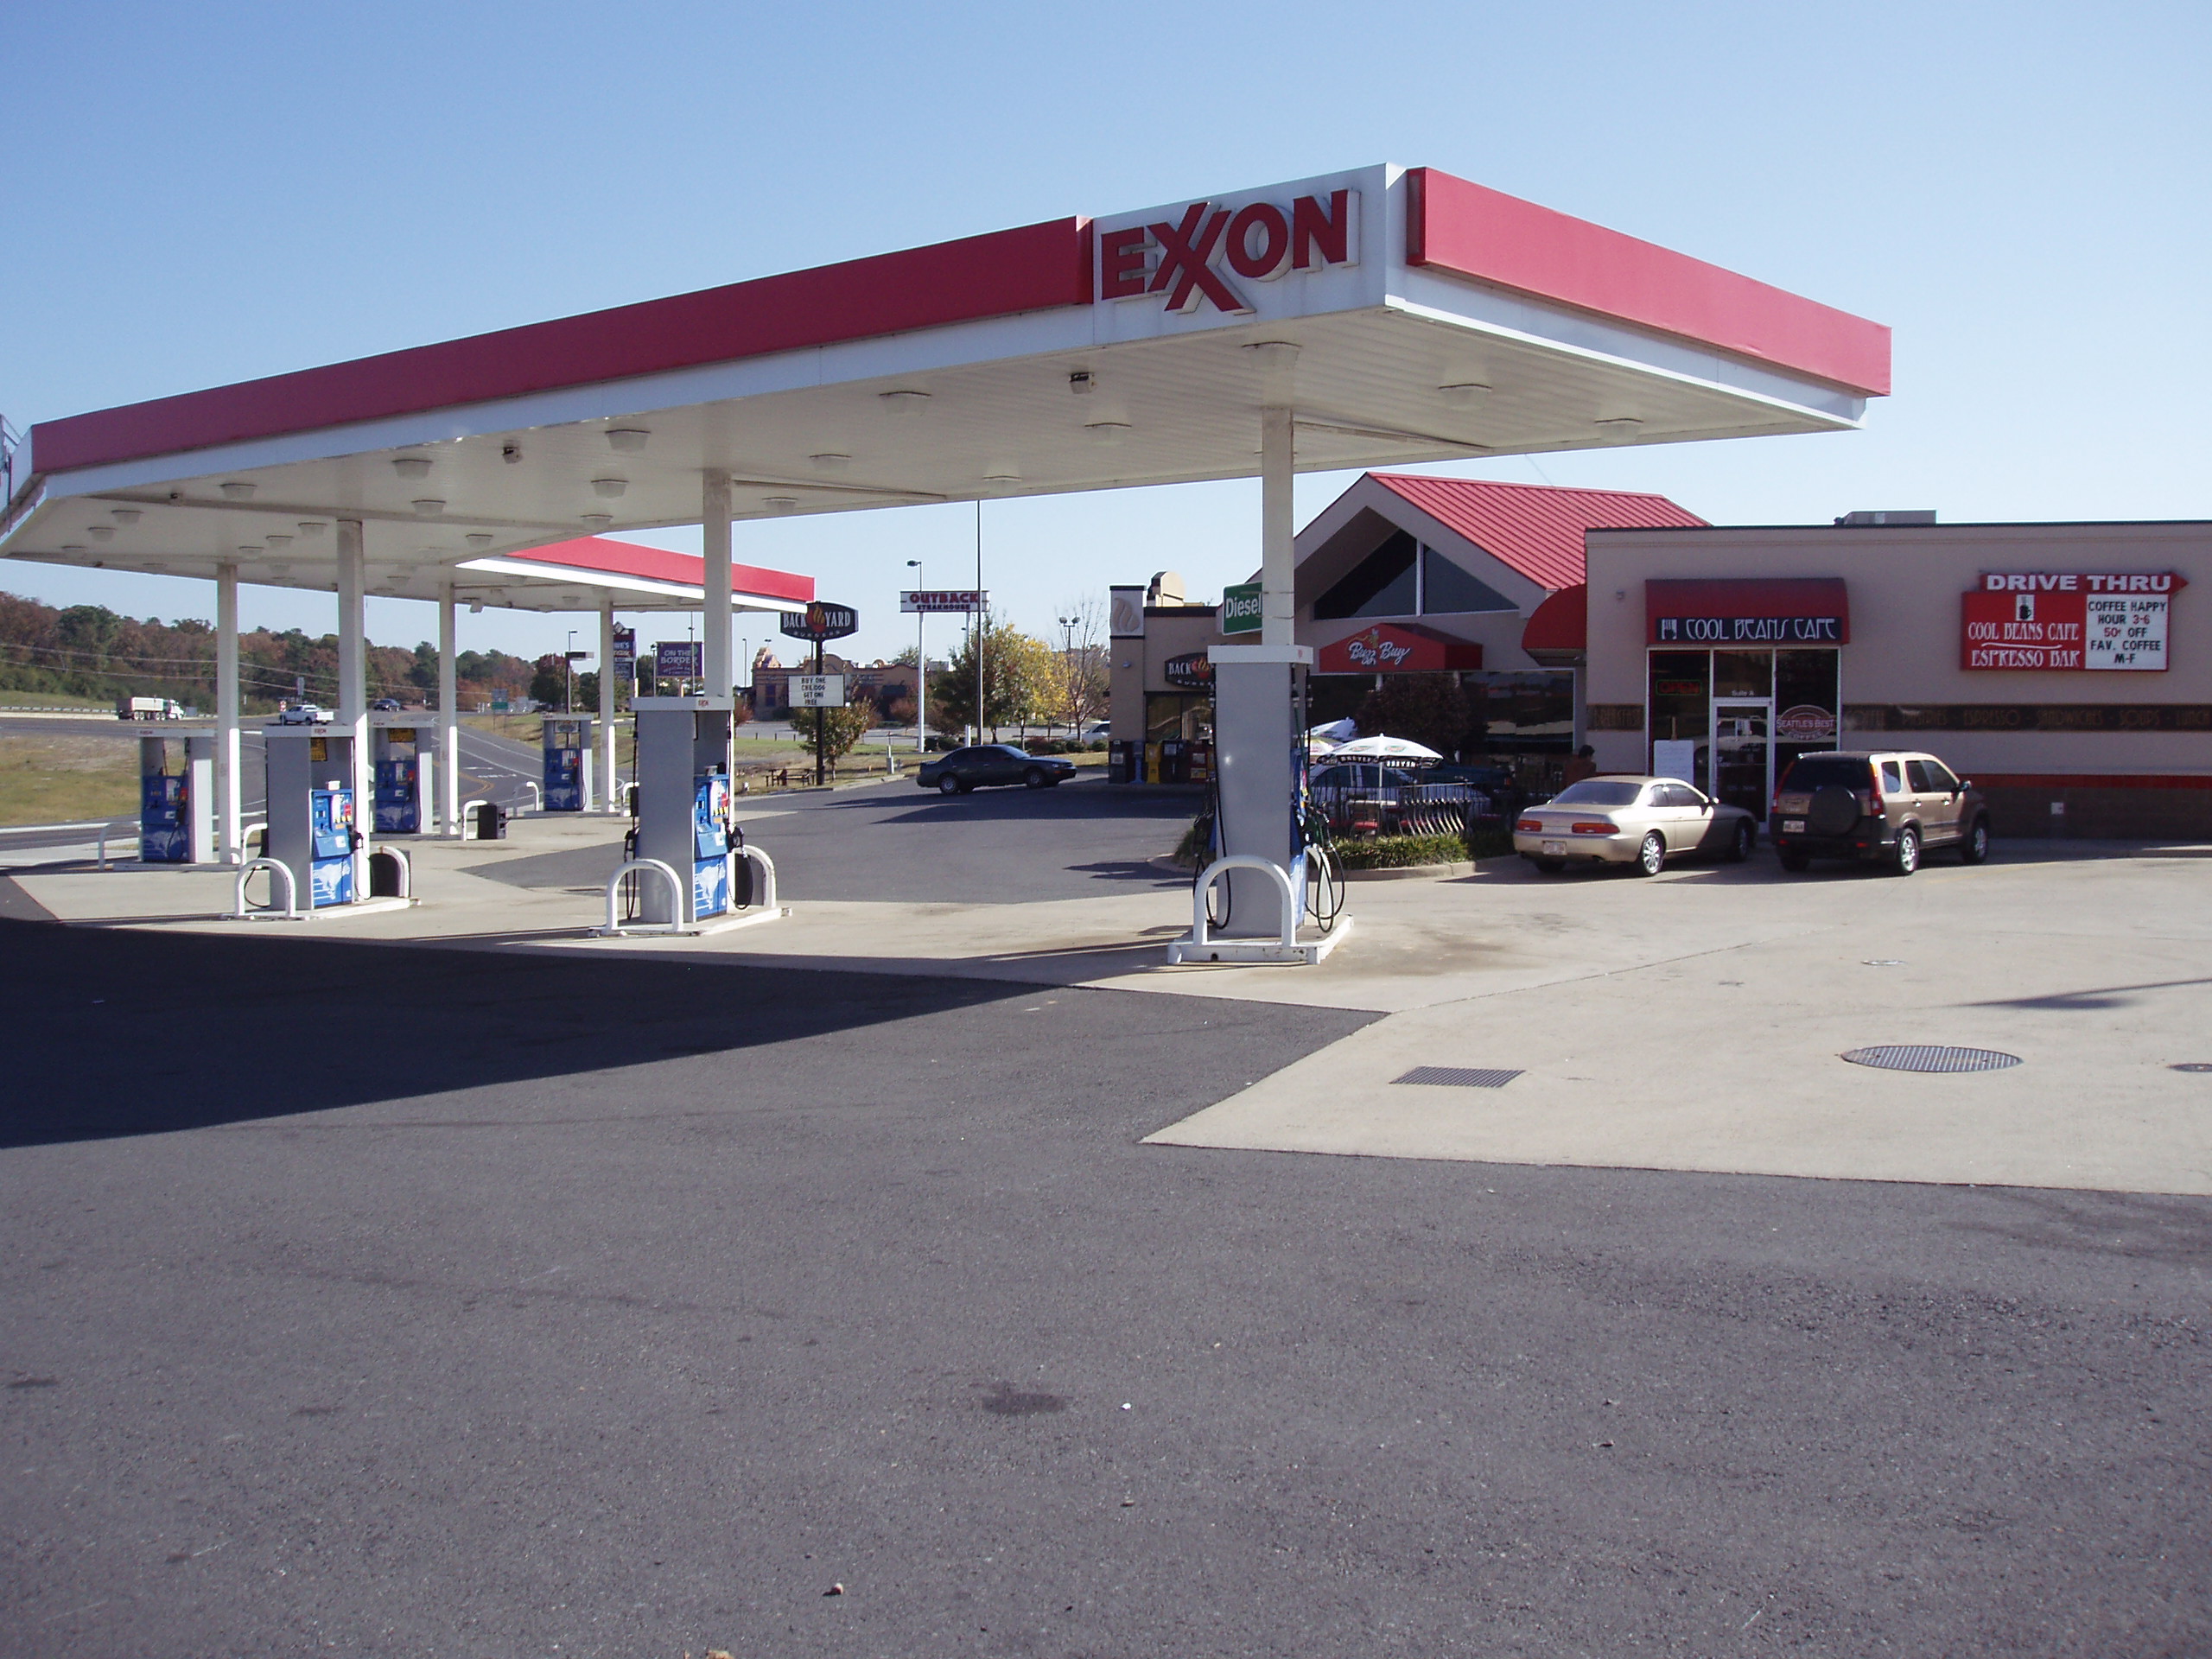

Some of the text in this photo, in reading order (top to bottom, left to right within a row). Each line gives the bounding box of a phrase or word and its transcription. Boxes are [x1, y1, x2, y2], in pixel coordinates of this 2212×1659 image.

[1101, 188, 1355, 312] EXXON
[1986, 574, 2171, 591] DRIVE THRU
[909, 593, 978, 603] OUTBACK
[1225, 593, 1262, 619] Diesel
[2088, 601, 2166, 612] COFFEE HAPPY
[783, 611, 851, 628] BACK YARD
[2098, 614, 2151, 625] HOUR 3-6
[1686, 619, 1837, 640] COOL BEANS CAFE
[1968, 622, 2079, 640] COOL BEANS CAFE
[2127, 627, 2148, 638] OFF
[2090, 640, 2162, 651] FAV. COFFEE
[1379, 641, 1411, 665] Buy
[1971, 650, 2082, 667] ESPRESSO BAR
[2113, 653, 2136, 664] M-F
[660, 657, 699, 666] BORDER
[1168, 662, 1192, 675] BACK
[1815, 718, 1834, 728] BEST
